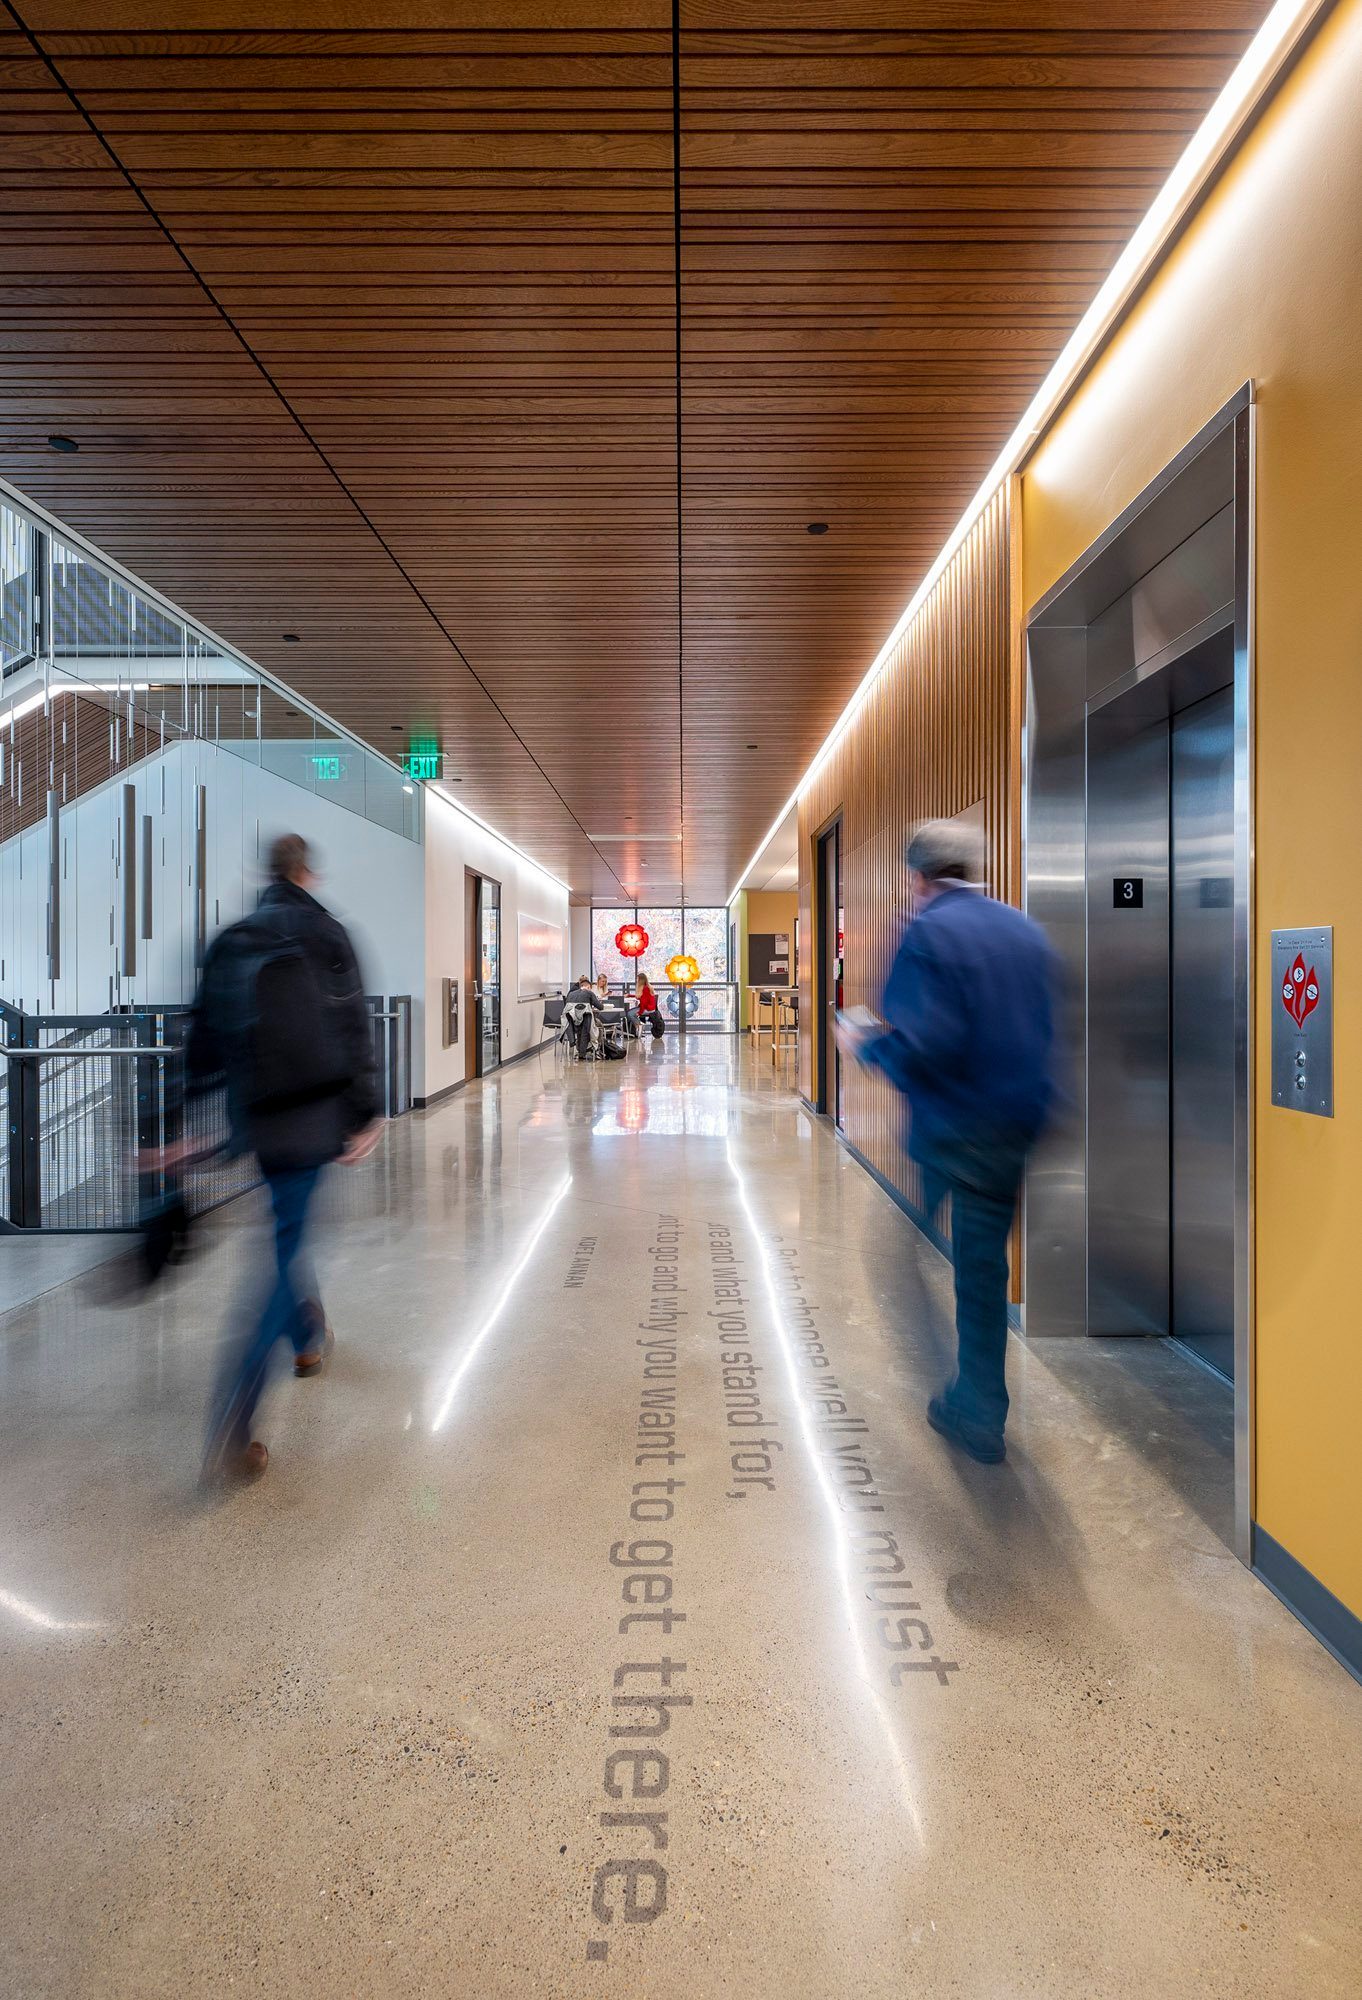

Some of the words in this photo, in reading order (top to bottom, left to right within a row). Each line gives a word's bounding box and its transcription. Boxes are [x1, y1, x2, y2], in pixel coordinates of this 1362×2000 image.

[410, 756, 438, 779] EXIT
[1123, 882, 1134, 899] 3
[575, 1236, 599, 1255] KOFI
[648, 1246, 679, 1262] go
[657, 1231, 684, 1243] to
[710, 1240, 744, 1263] and
[563, 1258, 592, 1289] ANNAN
[652, 1266, 687, 1292] and
[713, 1267, 750, 1305] what
[639, 1296, 688, 1334] why
[707, 1310, 747, 1345] you
[636, 1338, 677, 1379] you
[721, 1351, 779, 1427] stand
[804, 1375, 870, 1432] well
[635, 1387, 686, 1466] want
[725, 1438, 784, 1499] for,
[816, 1443, 885, 1512] you
[630, 1478, 686, 1522] to
[609, 1540, 687, 1634] get
[848, 1530, 961, 1687] must
[586, 1656, 693, 1962] there.
